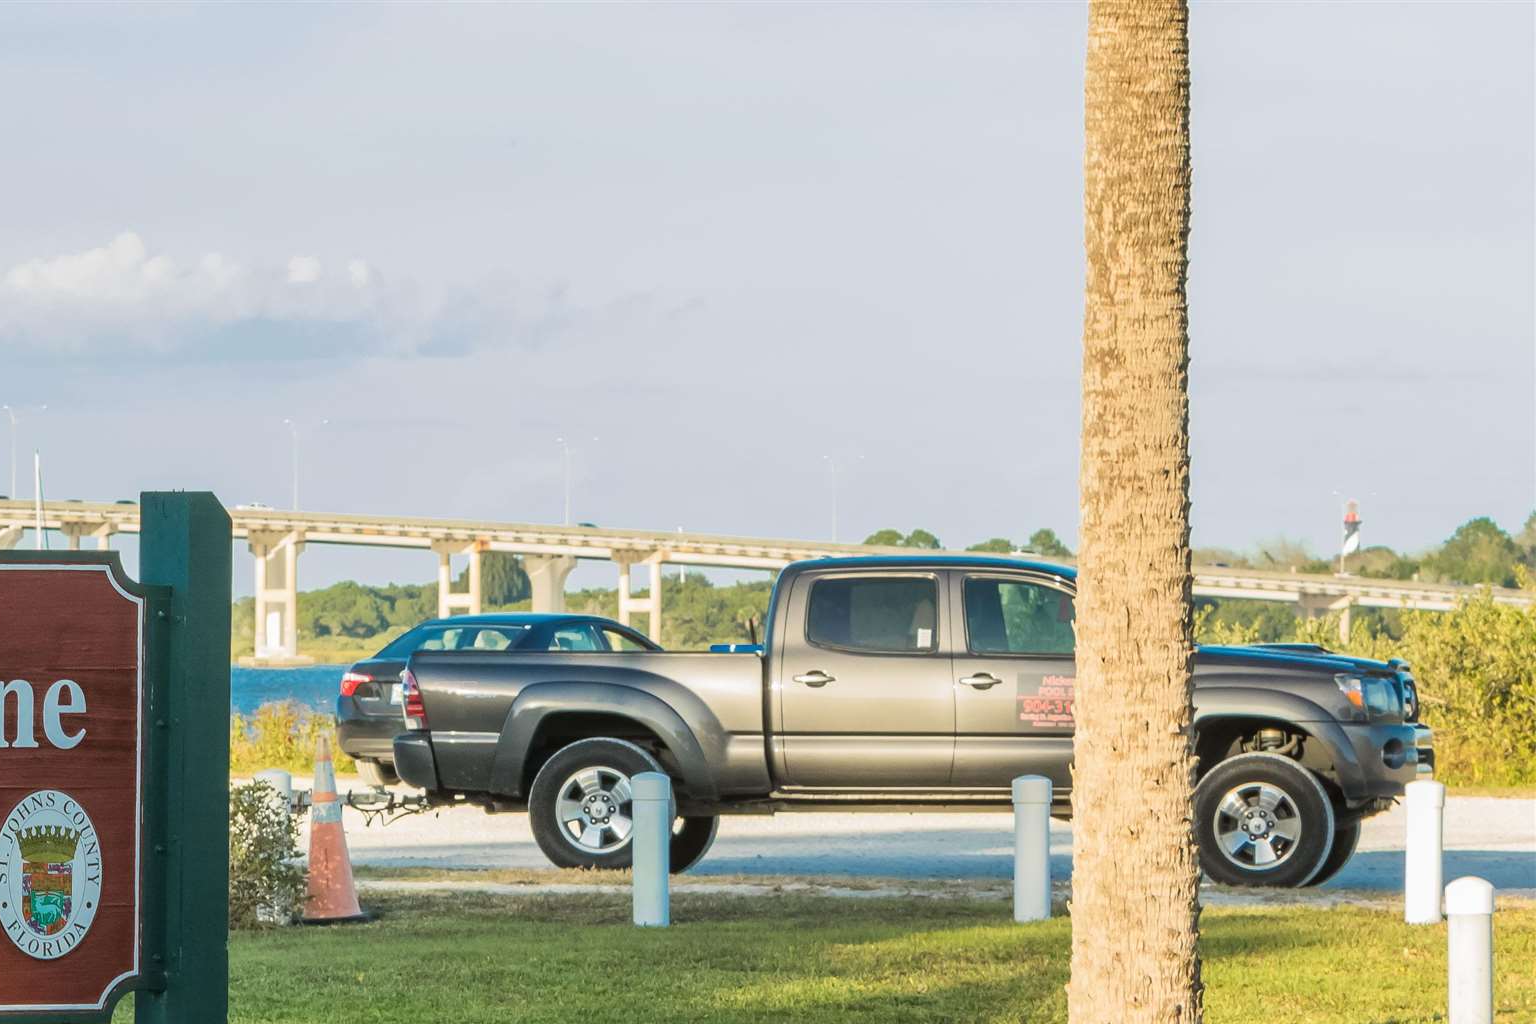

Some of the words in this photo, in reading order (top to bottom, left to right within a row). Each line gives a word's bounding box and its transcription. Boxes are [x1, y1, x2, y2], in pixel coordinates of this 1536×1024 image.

[2, 792, 56, 844] JOHNS
[63, 800, 100, 887] COUNTY
[7, 920, 86, 957] FLORIDA
